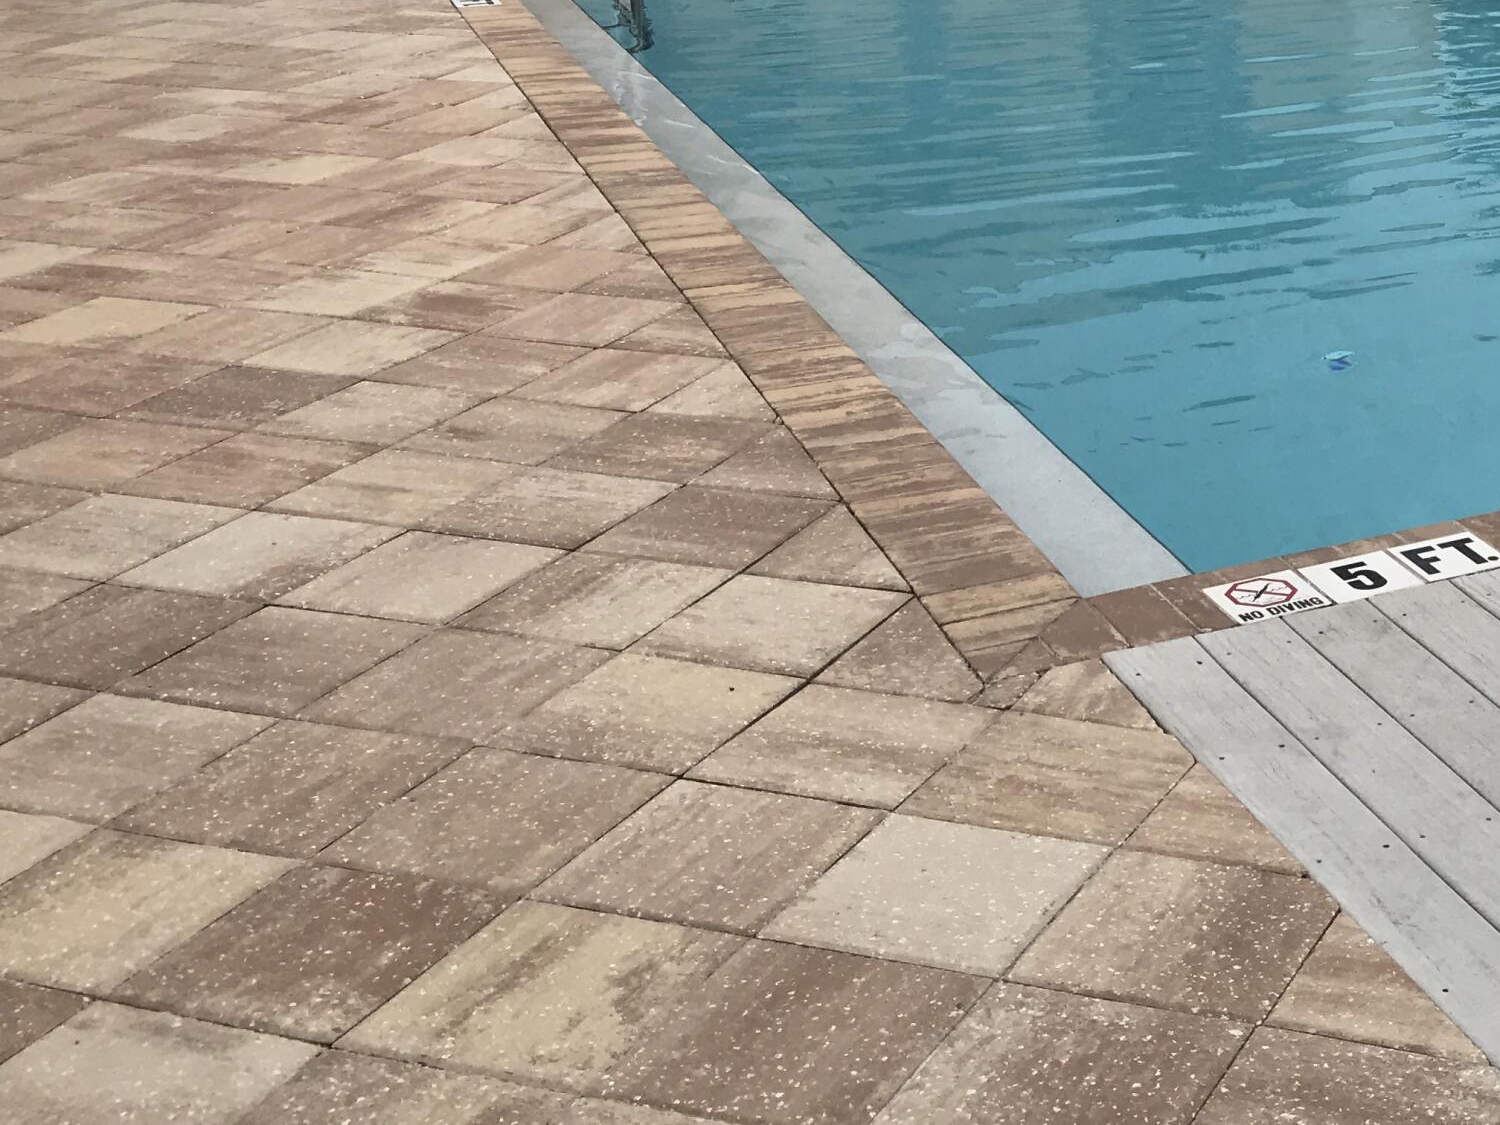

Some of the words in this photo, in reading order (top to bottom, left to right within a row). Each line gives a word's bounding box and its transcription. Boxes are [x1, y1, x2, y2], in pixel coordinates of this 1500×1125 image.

[1329, 561, 1388, 591] 5
[1238, 609, 1264, 623] NO
[1266, 596, 1323, 616] DIVING
